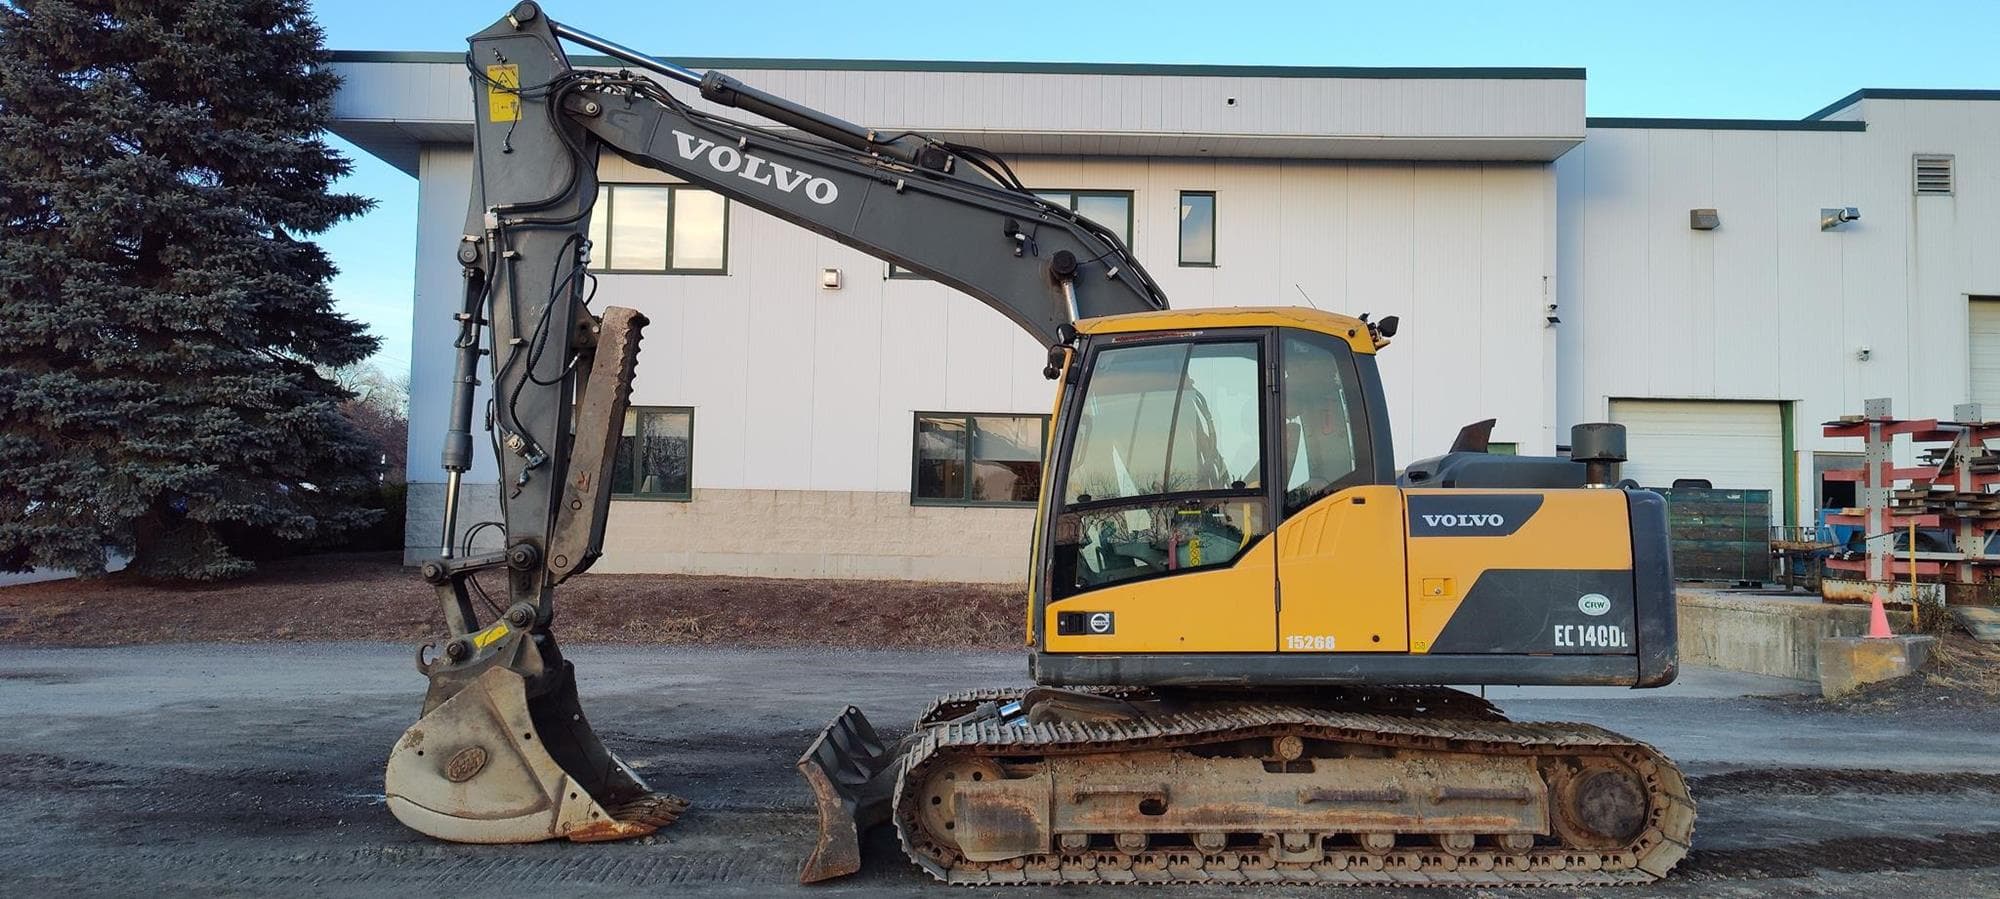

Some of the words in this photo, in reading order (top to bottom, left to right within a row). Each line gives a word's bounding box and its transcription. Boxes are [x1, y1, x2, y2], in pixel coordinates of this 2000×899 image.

[672, 130, 838, 204] VOLVO
[1422, 514, 1504, 527] VOLVO
[1584, 601, 1605, 609] CRW
[1554, 625, 1574, 647] EC
